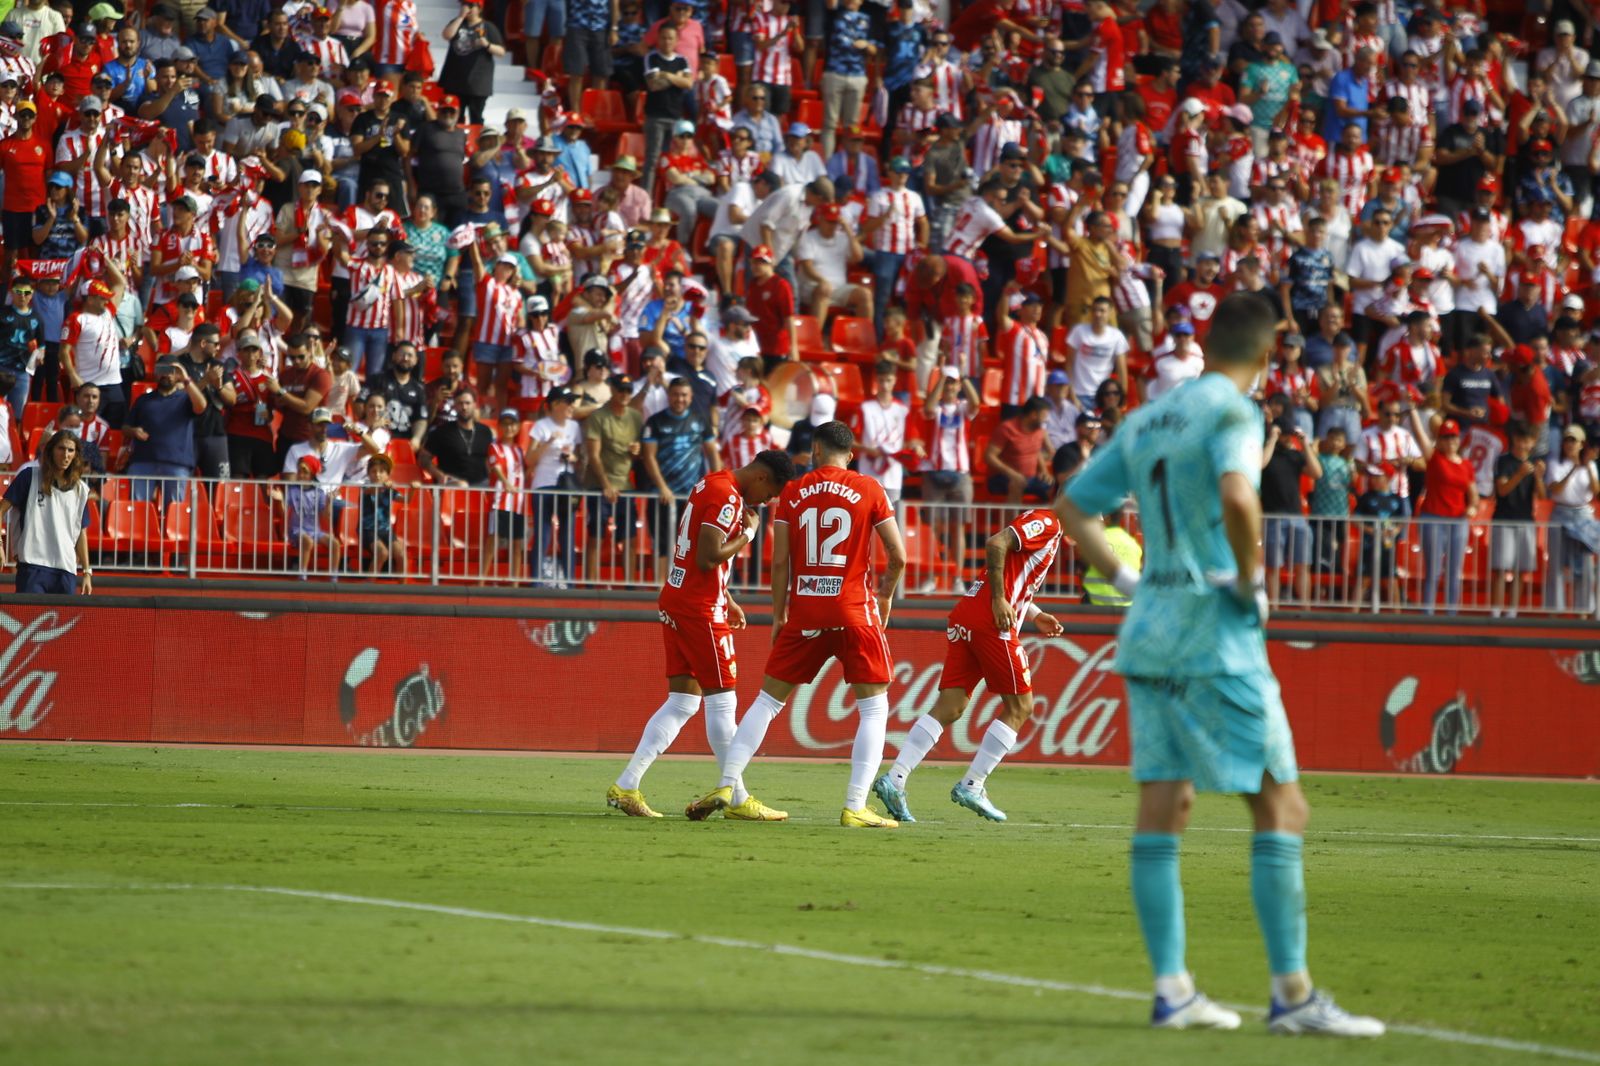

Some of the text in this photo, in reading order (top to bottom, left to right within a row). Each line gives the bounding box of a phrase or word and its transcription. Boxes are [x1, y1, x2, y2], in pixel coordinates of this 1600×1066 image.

[789, 499, 801, 509] L.
[1148, 457, 1177, 552] 1
[799, 506, 852, 568] 12
[818, 577, 842, 587] POWER
[817, 586, 841, 595] HORSE
